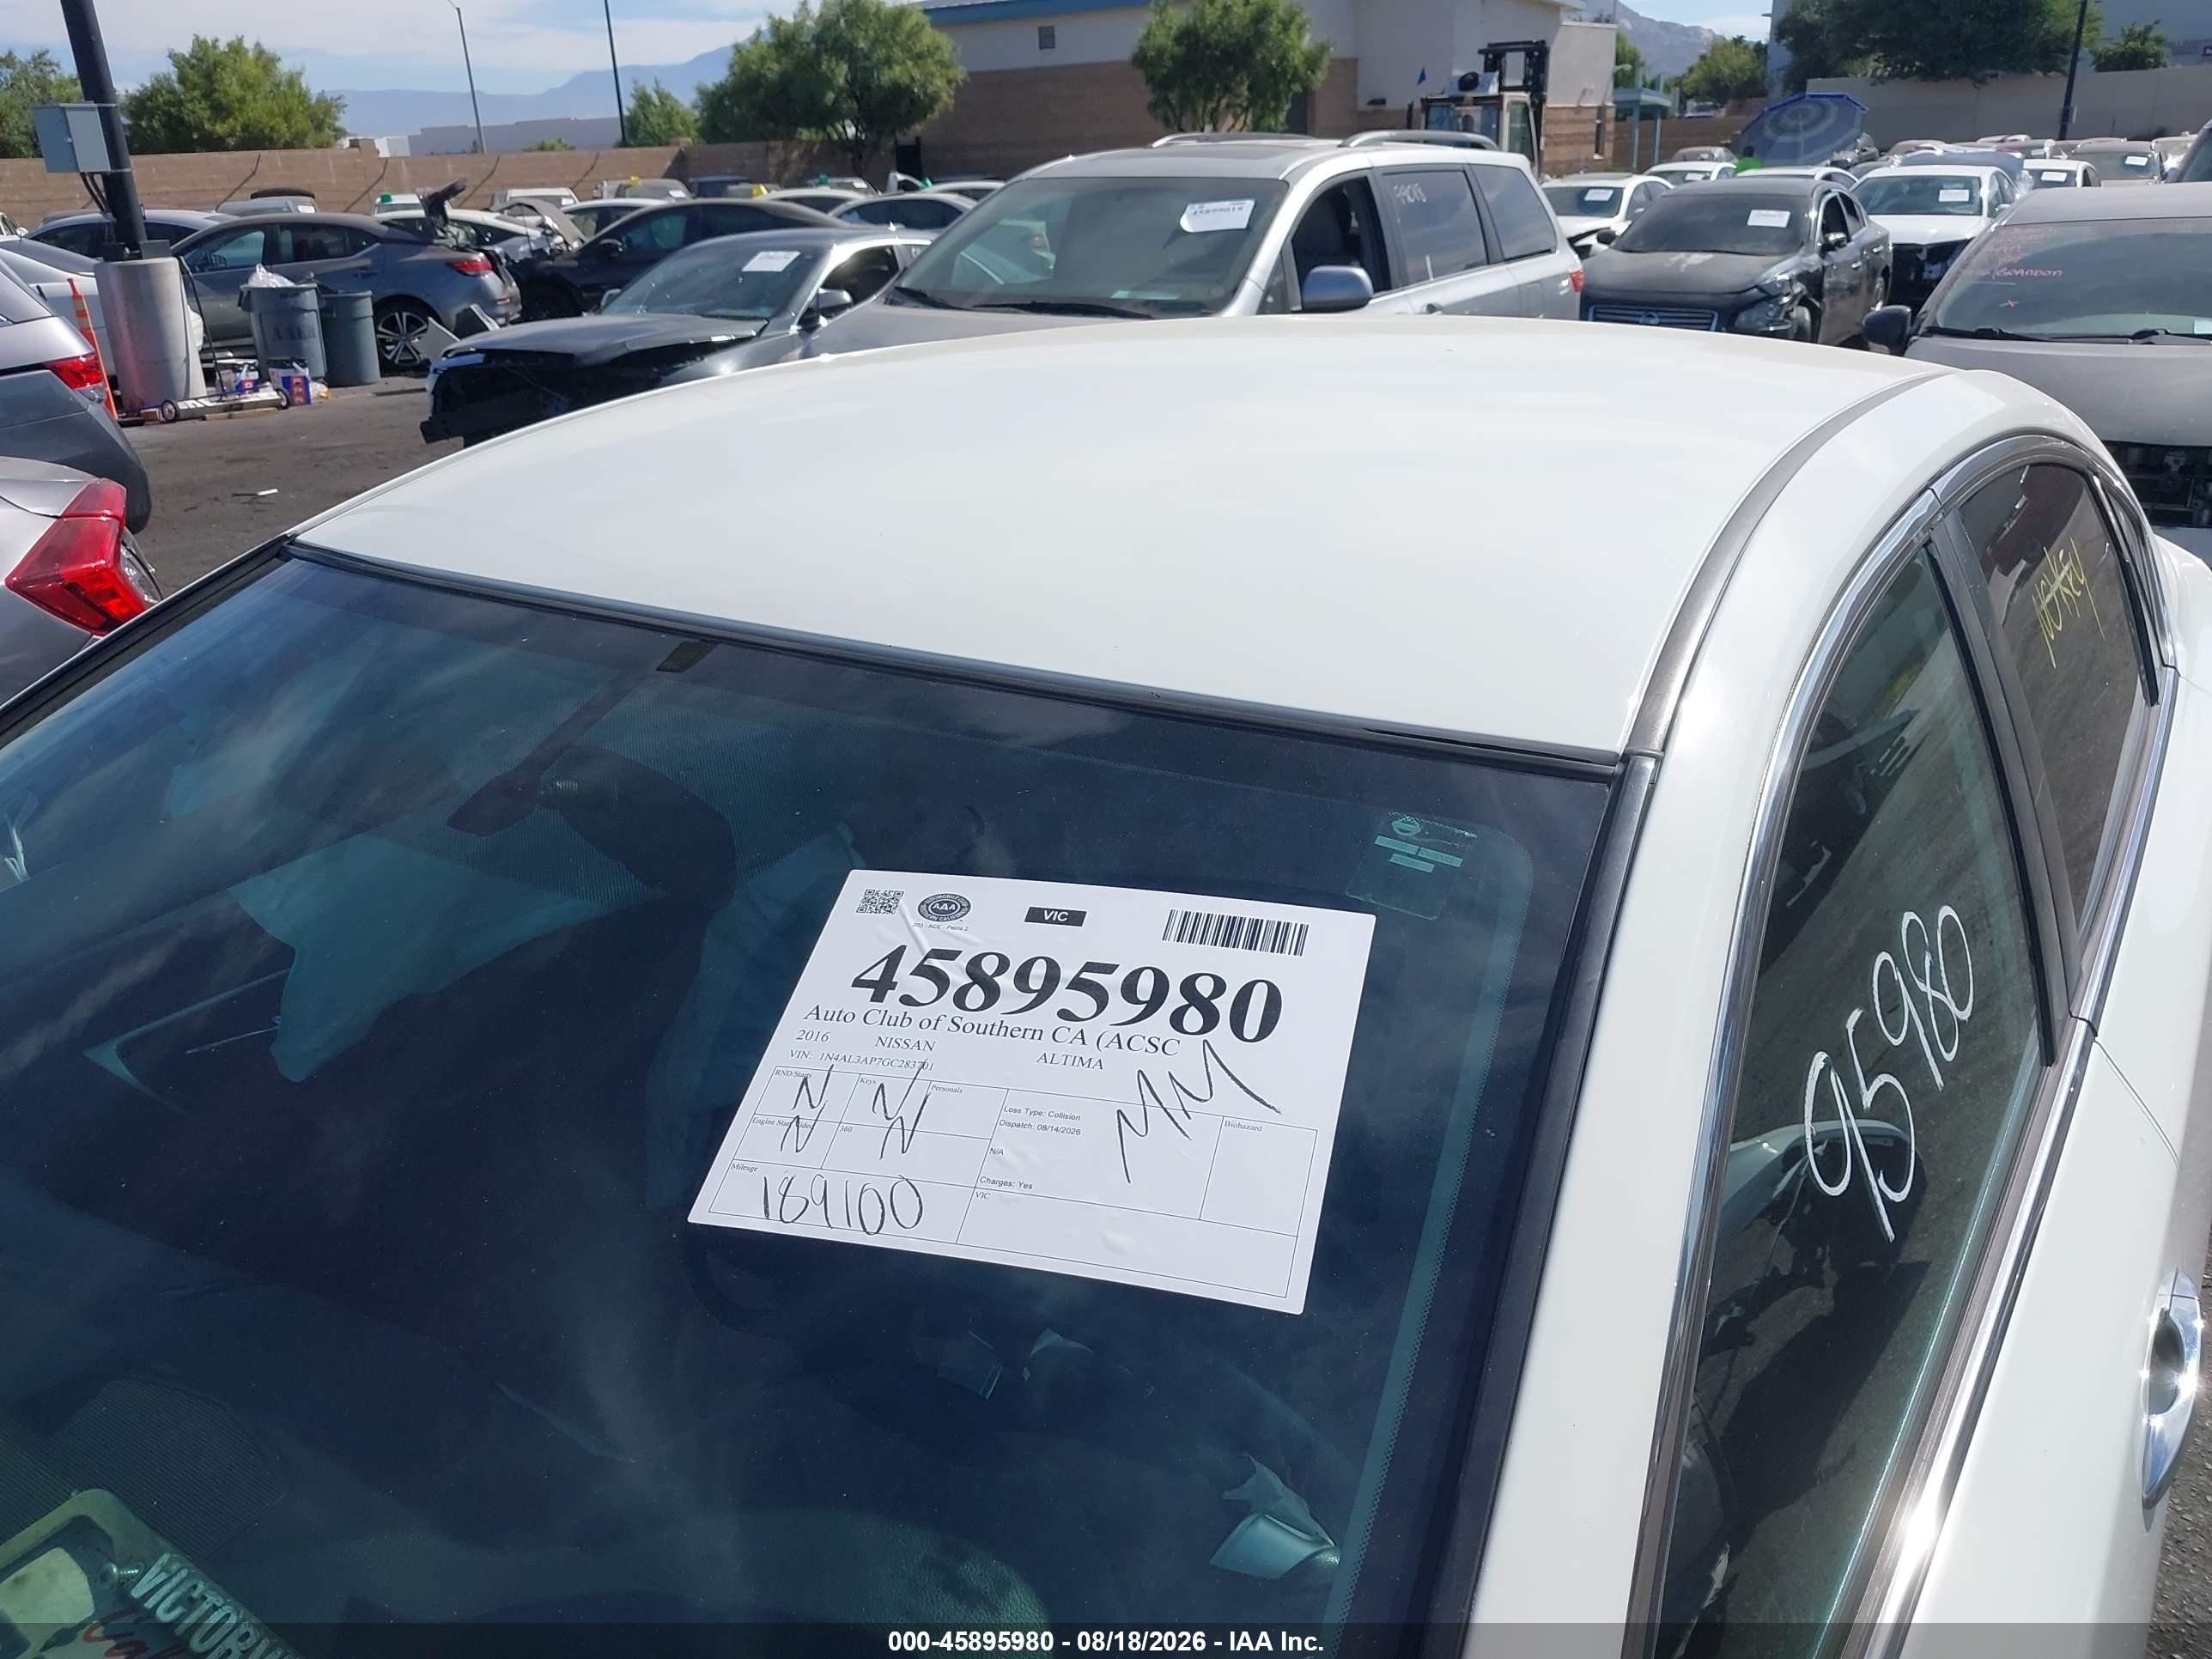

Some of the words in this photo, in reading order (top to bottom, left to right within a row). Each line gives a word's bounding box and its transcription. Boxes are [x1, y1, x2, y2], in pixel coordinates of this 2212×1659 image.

[1043, 910, 1069, 921] VIC
[851, 945, 1282, 1043] 45895980
[804, 1004, 856, 1024] Auto
[863, 1008, 913, 1029] Club
[919, 1014, 946, 1031] of
[947, 1015, 1044, 1042] Southern
[1051, 1025, 1088, 1046] CA
[1096, 1030, 1182, 1056] (ACSC
[789, 1048, 813, 1060] VIN:
[796, 1030, 830, 1042] 2016
[874, 1036, 937, 1052] NISSAN
[1036, 1052, 1105, 1071] ALTIMA
[1804, 905, 1974, 1243] 95980
[860, 1077, 877, 1086] Keys
[931, 1084, 963, 1094] Personals
[1003, 1105, 1022, 1114] Loss
[1024, 1108, 1046, 1116] Type:
[1048, 1110, 1081, 1121] Collision
[752, 1117, 775, 1126] Engine
[999, 1119, 1036, 1130] Dispatch:
[1036, 1124, 1081, 1135] 08/14/2026
[1224, 1120, 1263, 1133] Biohazard
[989, 1147, 1004, 1156] N/A
[731, 1163, 759, 1173] Mileage
[980, 1176, 1016, 1188] Charges:
[1018, 1181, 1033, 1189] Yes
[763, 1171, 923, 1236] 189100
